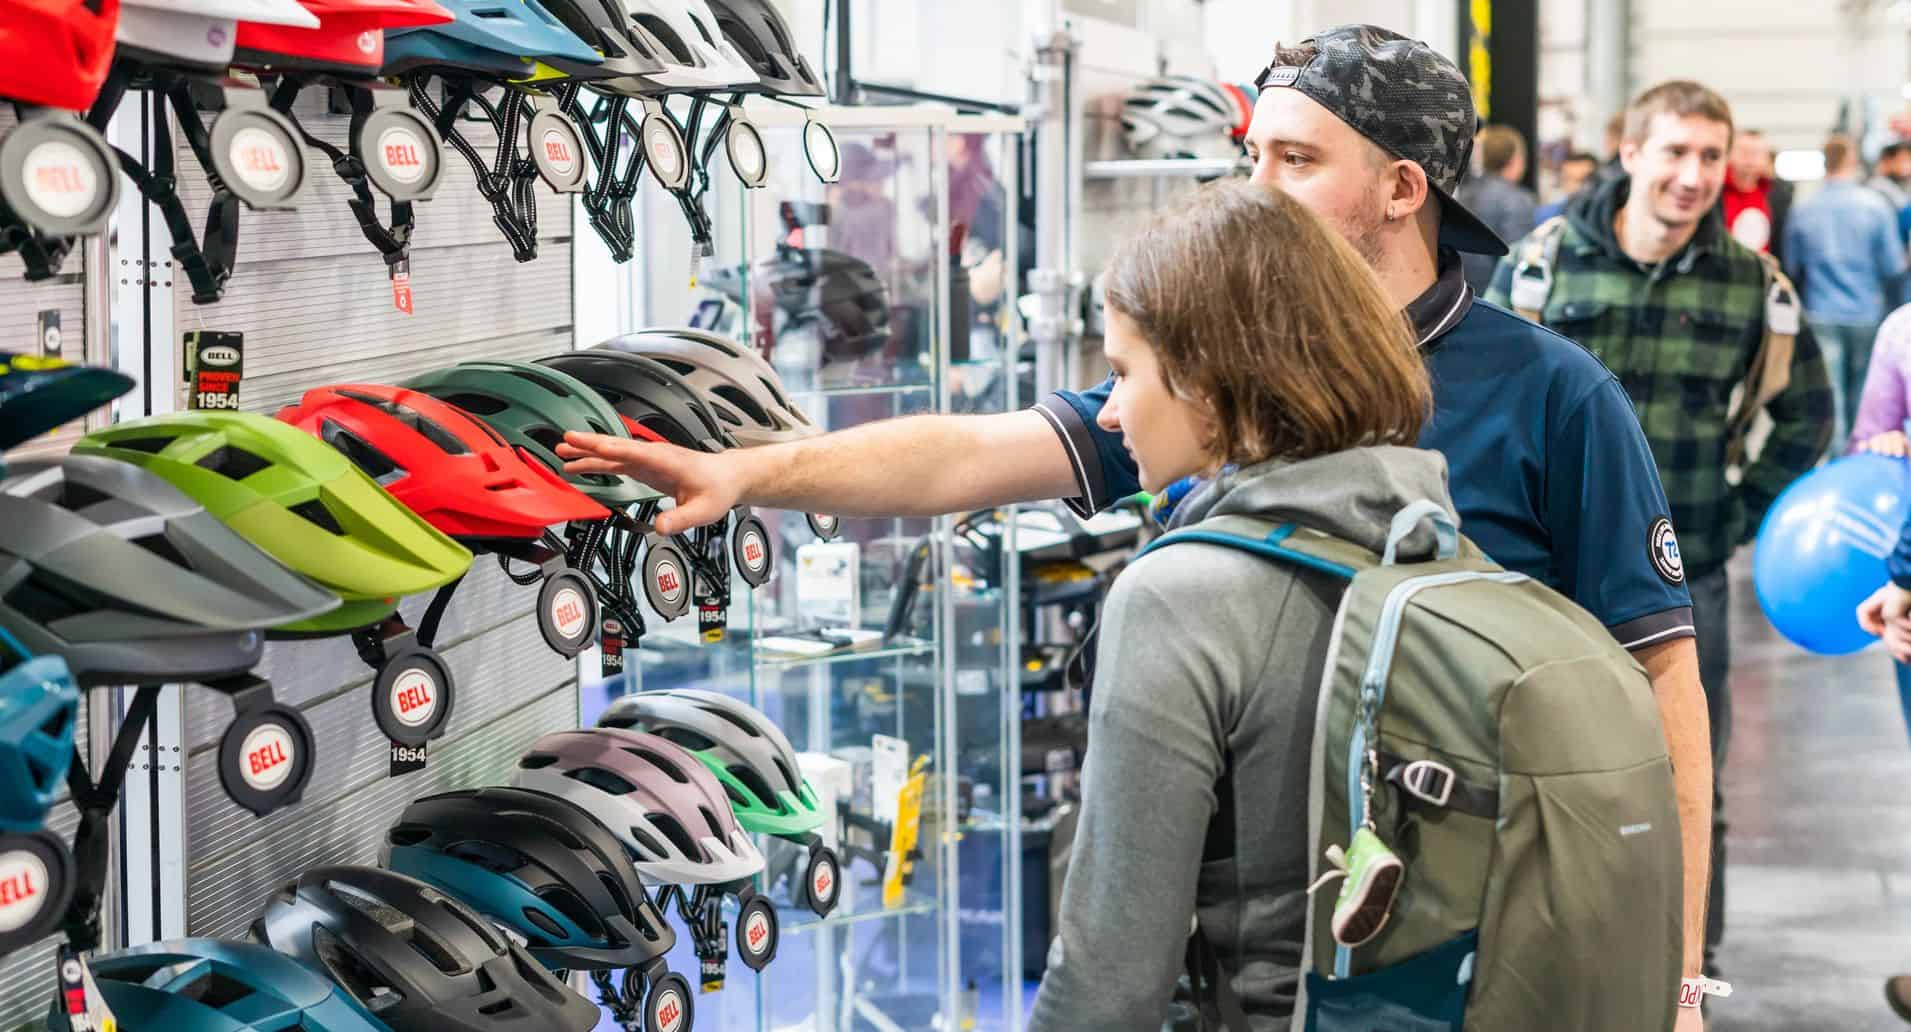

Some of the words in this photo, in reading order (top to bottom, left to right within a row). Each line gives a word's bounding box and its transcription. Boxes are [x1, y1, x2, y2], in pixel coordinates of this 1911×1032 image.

[384, 144, 420, 167] BELL
[546, 143, 570, 161] BELL
[207, 352, 233, 360] BELL
[197, 392, 239, 409] 1954
[746, 543, 762, 561] BELL
[1664, 540, 1679, 559] 72
[657, 571, 679, 593] BELL
[556, 601, 582, 628] BELL
[700, 610, 726, 622] 1954
[602, 654, 623, 667] 1954
[397, 683, 431, 713] BELL
[248, 740, 287, 775] BELL
[391, 746, 426, 762] 1954
[0, 870, 37, 907] ELL
[749, 919, 766, 946] BELL
[702, 962, 726, 975] 1954
[659, 998, 679, 1028] BELL
